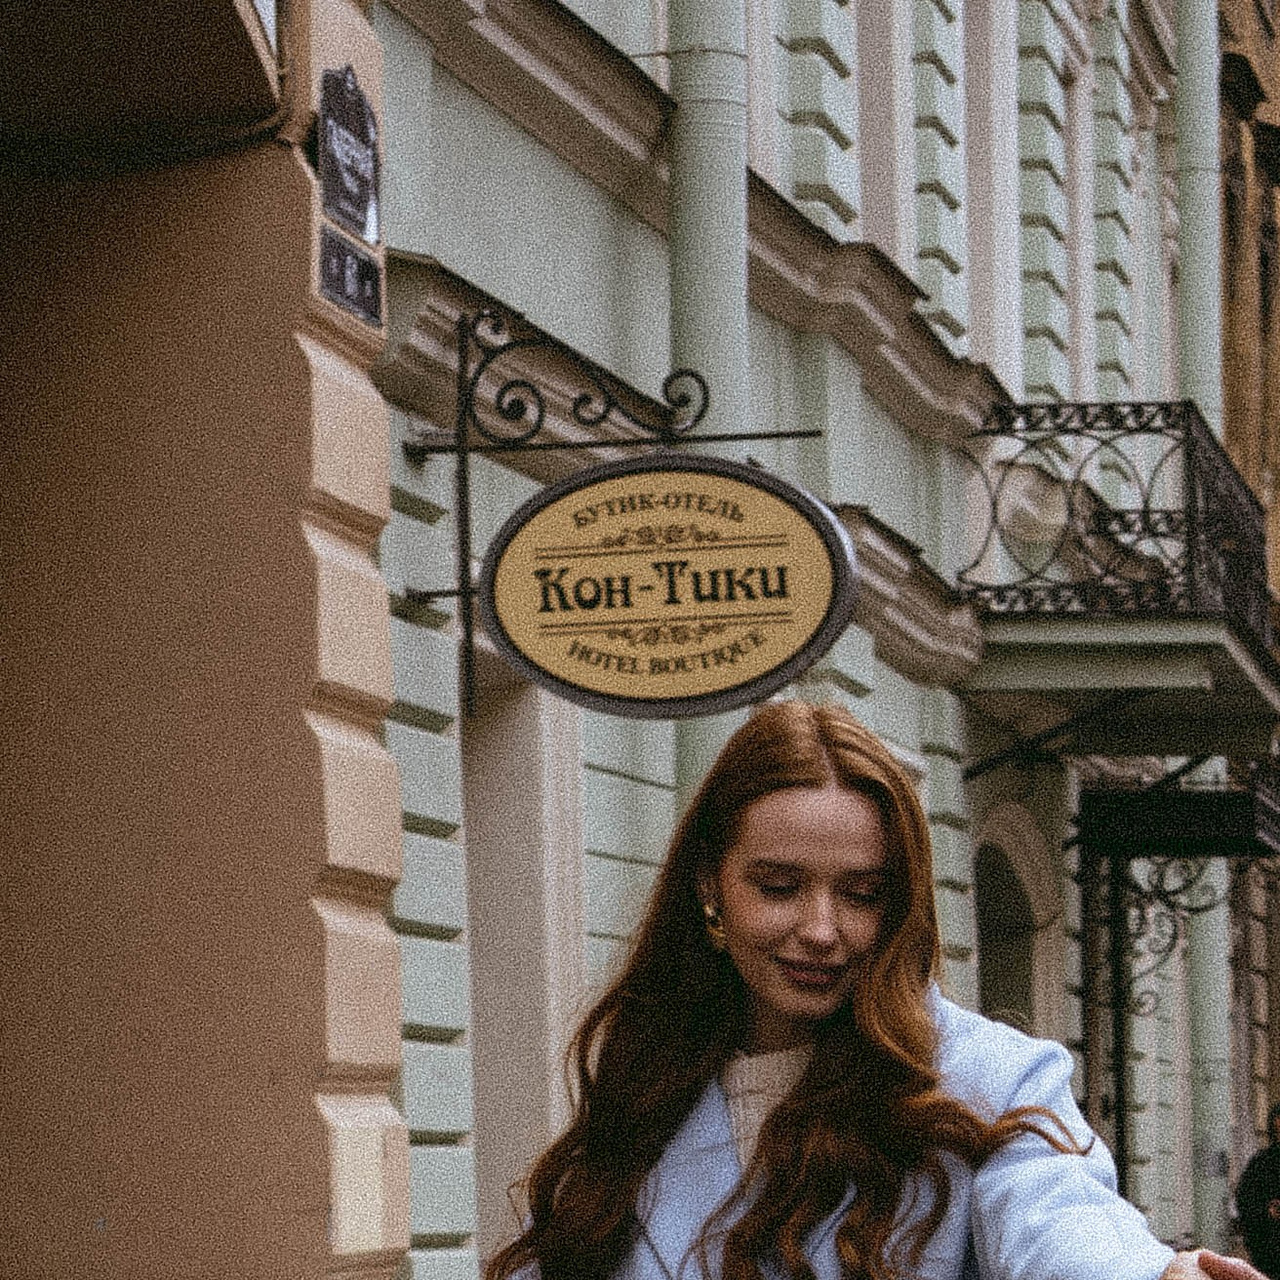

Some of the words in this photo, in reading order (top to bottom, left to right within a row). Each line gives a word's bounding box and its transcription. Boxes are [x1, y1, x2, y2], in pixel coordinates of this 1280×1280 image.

[572, 491, 745, 529] БУТИК-ОТЕЛЬ
[532, 560, 790, 614] Кон-Тики
[567, 640, 642, 675] HOTEL
[648, 630, 767, 677] BOUTIQUE
